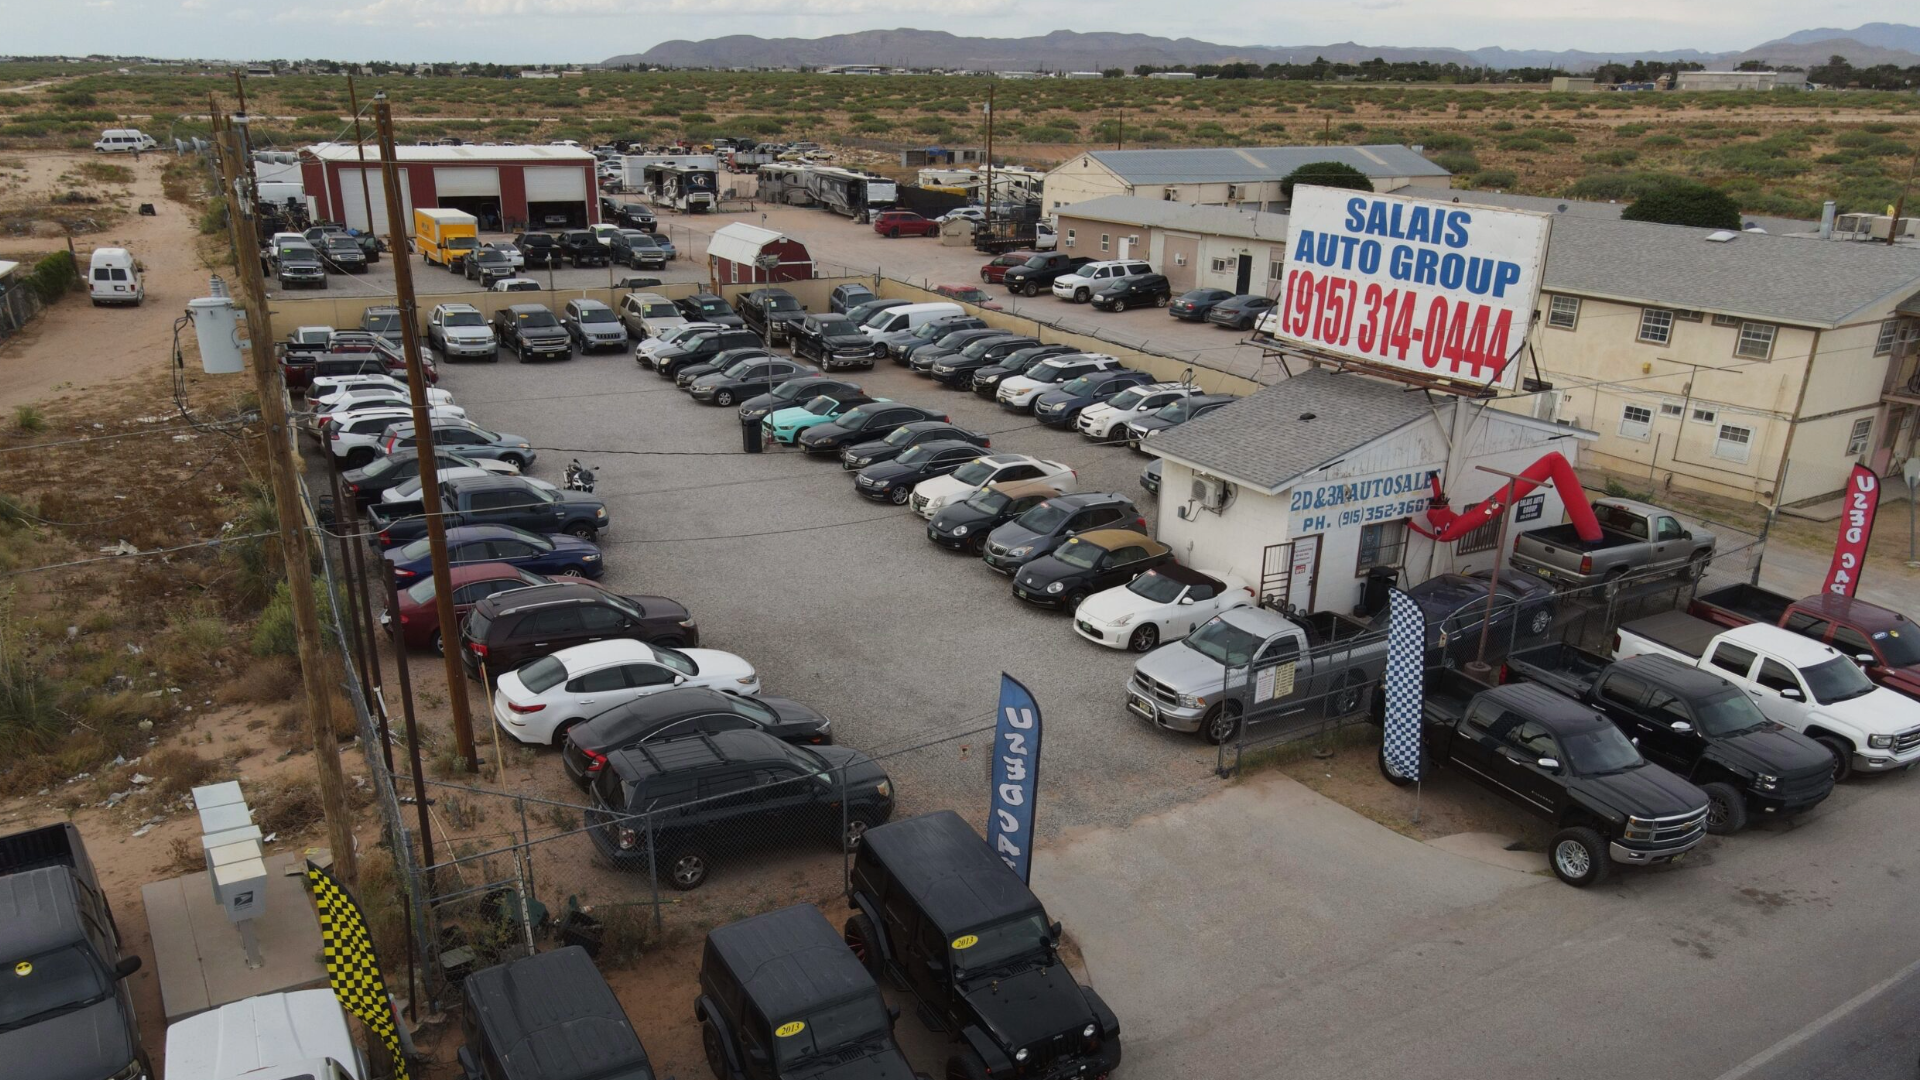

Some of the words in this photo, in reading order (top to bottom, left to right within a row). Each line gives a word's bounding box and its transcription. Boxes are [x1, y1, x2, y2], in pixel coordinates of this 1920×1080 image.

[1345, 197, 1471, 248] SALAIS
[1294, 229, 1381, 274] AUTO
[1389, 244, 1521, 298] GROUP
[1282, 269, 1358, 346] (915)
[1357, 283, 1513, 383] 314-0444
[1350, 468, 1442, 502] AUTOSALE
[1302, 515, 1331, 532] PH.
[956, 936, 974, 948] 2013
[781, 1022, 800, 1035] 2013
